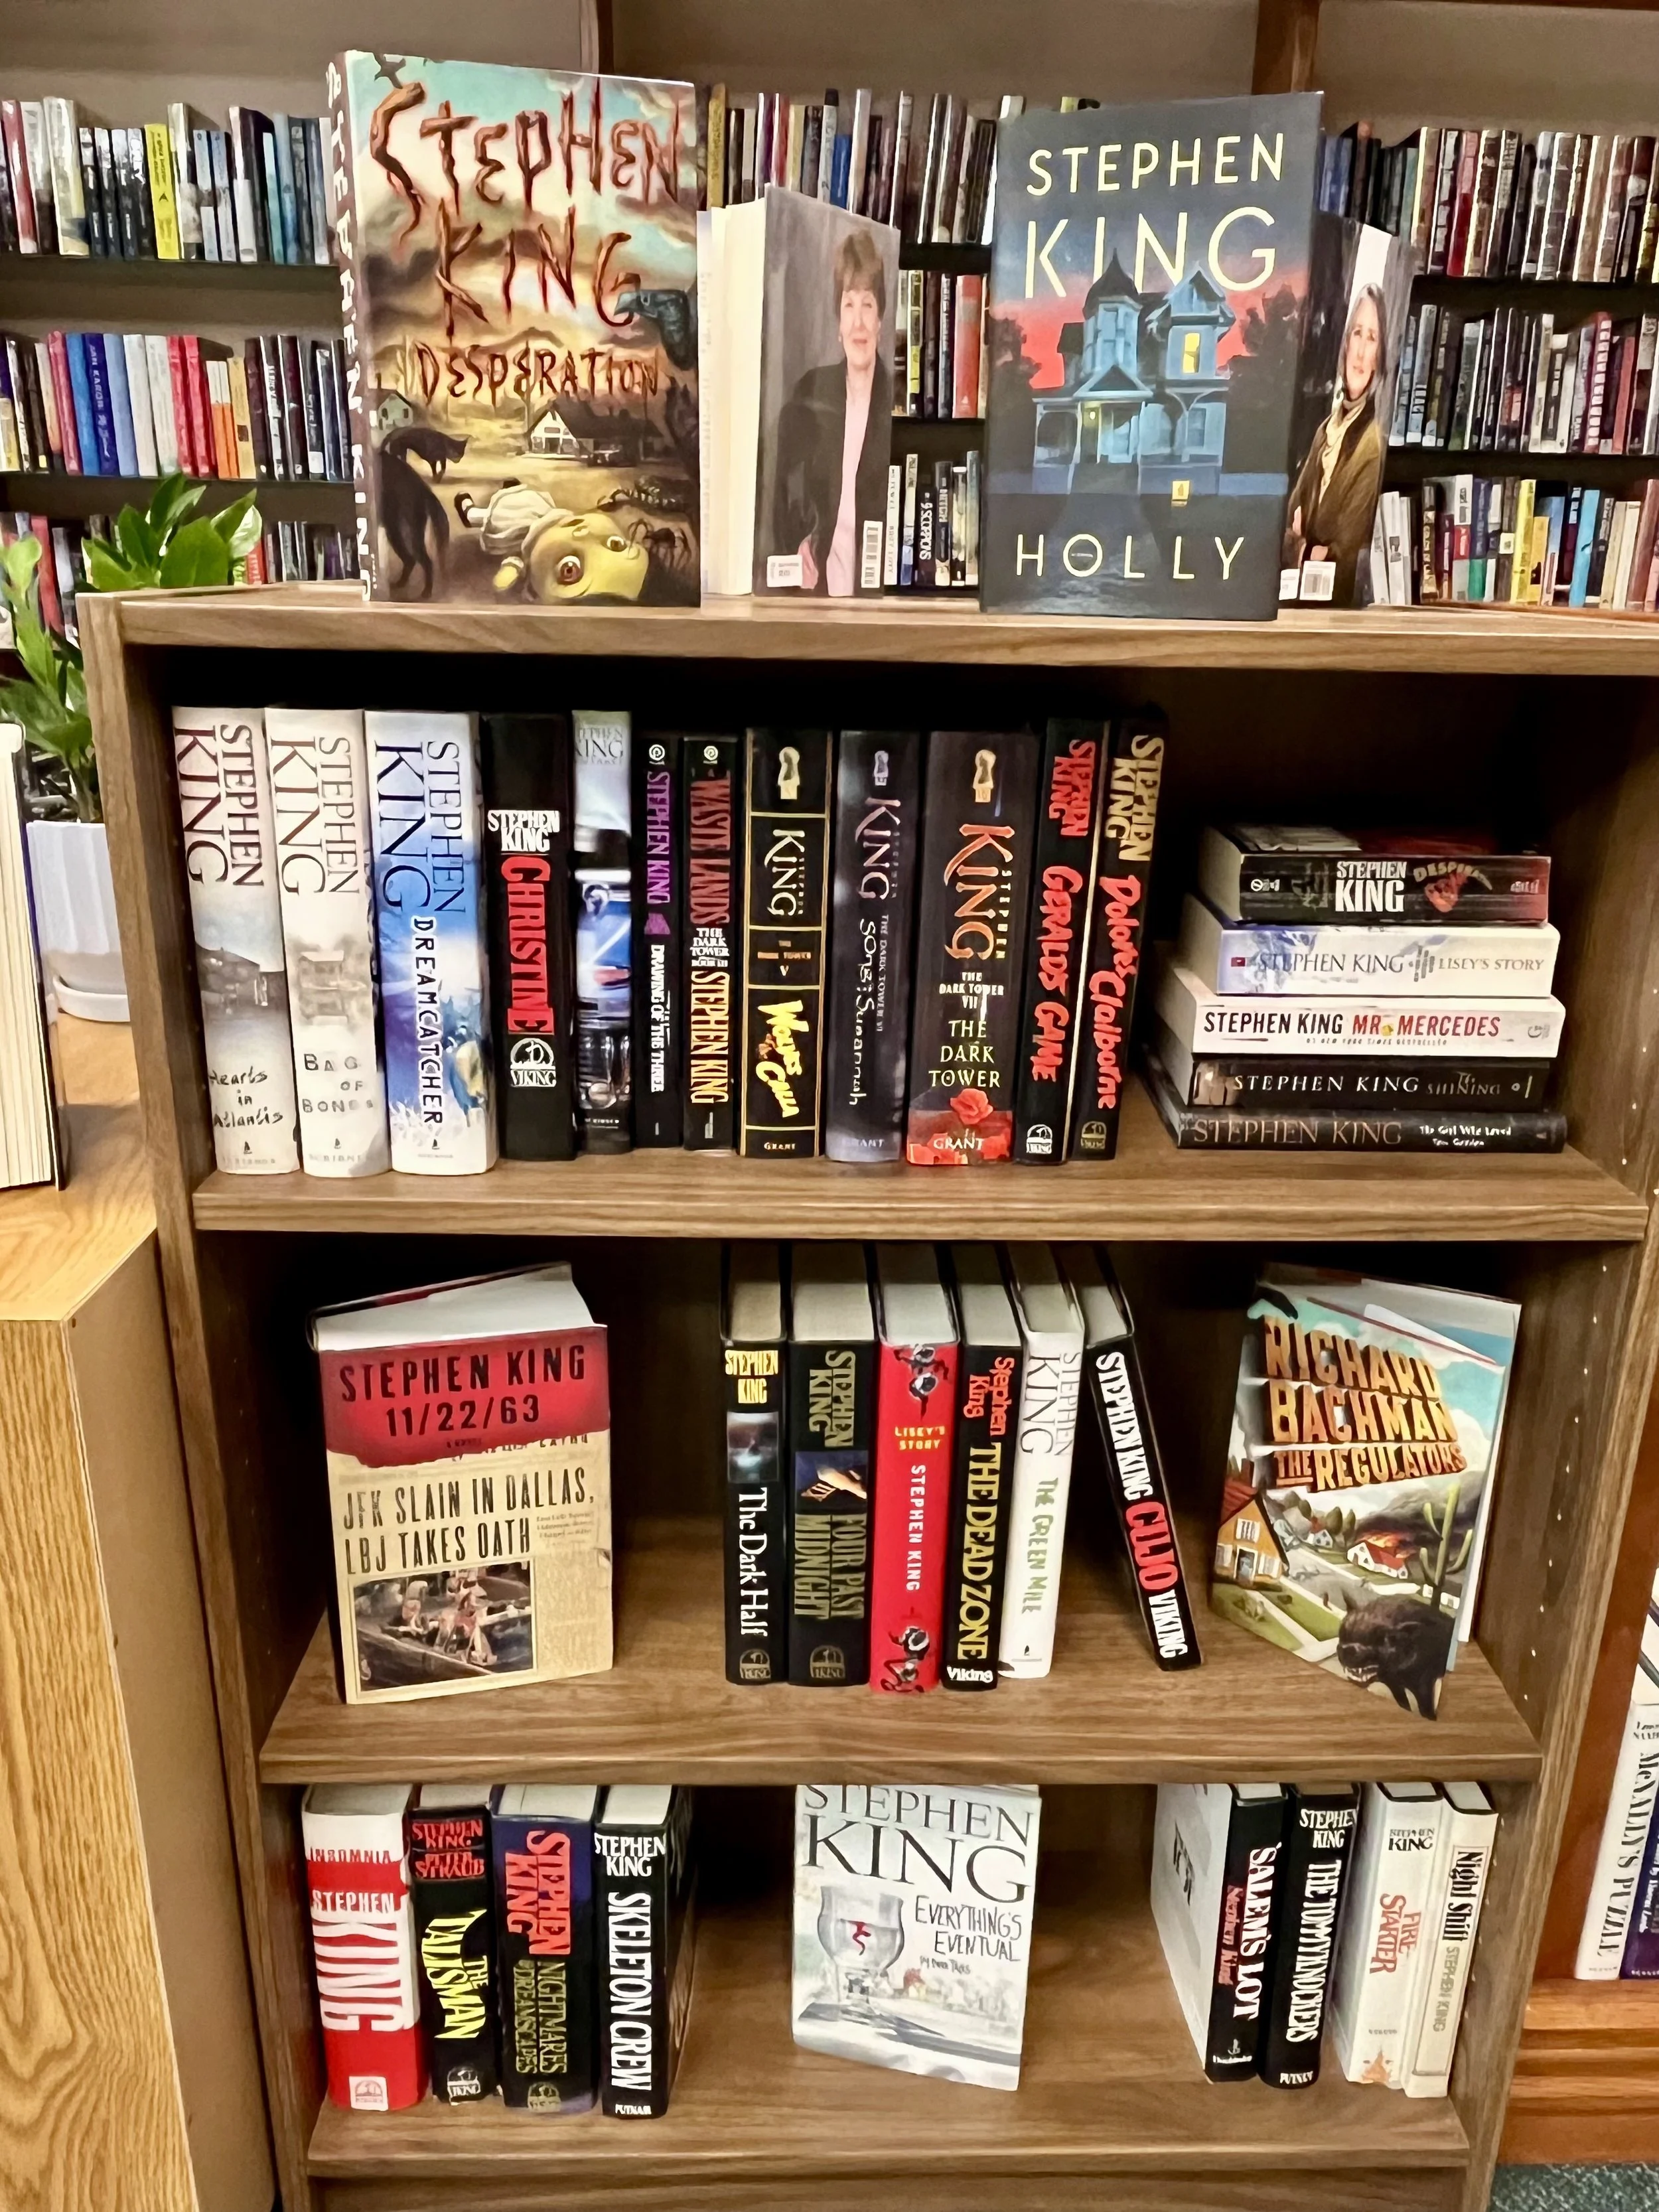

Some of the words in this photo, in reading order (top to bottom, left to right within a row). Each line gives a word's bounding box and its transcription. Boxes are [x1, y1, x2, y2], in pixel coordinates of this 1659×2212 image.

[370, 78, 680, 251] STEPHEN
[1027, 133, 1284, 196] STEPHEN
[435, 199, 641, 344] KING
[1024, 206, 1277, 299] KING
[411, 338, 661, 407] DESPERATION
[1015, 533, 1244, 581] HOLLY
[174, 725, 229, 884] KING
[220, 724, 264, 886] STEPHEN
[270, 735, 326, 896] KING
[319, 737, 360, 893] STEPHEN
[647, 771, 670, 855] STEPHEN
[1048, 756, 1072, 820] KING
[1060, 739, 1096, 836] STEPHEN
[1104, 757, 1138, 839] KING
[1118, 734, 1165, 861] STEPHEN
[374, 739, 431, 911] KING
[427, 741, 466, 913] STEPHEN
[488, 810, 560, 834] STEPHEN
[501, 827, 550, 853] KING
[855, 796, 901, 901] KING
[647, 860, 670, 904] KING
[690, 858, 731, 924] LANDS
[764, 829, 805, 916] KING
[943, 823, 1015, 960] KING
[1334, 879, 1406, 913] KING
[1335, 860, 1407, 879] STEPHEN
[501, 856, 555, 1035] CHRISTINE
[1259, 953, 1346, 973] STEPHEN
[1352, 953, 1406, 974] KING
[1494, 958, 1545, 972] STORY
[691, 970, 730, 1055] STEPHEN
[939, 984, 966, 995] DARK
[413, 918, 443, 1124] DREAMCATCHER
[948, 1020, 987, 1039] THE
[1030, 1001, 1070, 1083] GAME
[1204, 1011, 1291, 1035] STEPHEN
[1297, 1013, 1344, 1035] KING
[1397, 1015, 1502, 1037] MERCEDES
[304, 1053, 359, 1071] BAG
[510, 1069, 557, 1087] VIKING
[689, 1059, 729, 1104] KING
[928, 1069, 1001, 1088] TOWER
[940, 1045, 995, 1064] DARK
[1233, 1074, 1344, 1093] STEPHEN
[1356, 1076, 1421, 1093] KING
[238, 1089, 253, 1106] in
[340, 1080, 364, 1091] OF
[933, 1137, 985, 1150] GRANT
[1194, 1118, 1319, 1144] STEPHEN
[1332, 1120, 1402, 1145] KING
[339, 1353, 490, 1402] STEPHEN
[506, 1345, 585, 1386] KING
[725, 1350, 778, 1376] STEPHEN
[1264, 1314, 1443, 1400] RICHARD
[386, 1394, 540, 1437] 11/22/63
[738, 1378, 767, 1404] KING
[808, 1368, 833, 1432] KING
[825, 1350, 856, 1447] STEPHEN
[963, 1374, 991, 1418] King
[989, 1356, 1015, 1437] Stephen
[1020, 1353, 1064, 1455] KING
[1053, 1352, 1082, 1457] STEPHEN
[1096, 1351, 1144, 1450] STEPHEN
[1268, 1379, 1459, 1443] BACHMAN
[966, 1441, 1002, 1502] THE
[1116, 1445, 1153, 1501] KING
[1274, 1450, 1313, 1480] THE
[1313, 1441, 1469, 1492] REGULATORS
[343, 1490, 383, 1530] JFK
[394, 1480, 461, 1524] SLAIN
[472, 1477, 494, 1514] IN
[506, 1466, 595, 1511] DALLAS,
[738, 1487, 768, 1530] The
[907, 1464, 926, 1544] STEPHEN
[344, 1534, 387, 1576] LBJ
[398, 1525, 465, 1570] TAKES
[477, 1517, 530, 1559] OATH
[739, 1533, 768, 1585] Dark
[794, 1512, 831, 1620] MIDNIGHT
[905, 1550, 922, 1592] KING
[962, 1503, 998, 1582] DEAD
[1027, 1514, 1054, 1570] GREEN
[1125, 1501, 1179, 1590] CUJO
[740, 1588, 769, 1637] Half
[957, 1583, 993, 1660] ZONE
[1148, 1589, 1189, 1659] VIKING
[946, 1664, 994, 1684] Viking
[594, 1832, 666, 1858] STEPHEN
[804, 1785, 1033, 1847] STEPHEN
[1312, 1829, 1346, 1849] KING
[1388, 1836, 1433, 1852] KING
[606, 1856, 652, 1877] KING
[801, 1812, 1032, 1903] KING
[1304, 1859, 1342, 1899] THE
[1449, 1850, 1484, 1898] Night
[505, 1852, 539, 1935] KING
[526, 1829, 571, 1955] STEPHEN
[915, 1894, 1023, 1941] EVERYTHING'S
[1441, 1902, 1475, 1942] Shift
[607, 1891, 653, 2017] SKELETON
[934, 1931, 1021, 1962] EVENTUAL
[1368, 1893, 1407, 1975] STARTER
[1398, 1910, 1422, 1958] FIRE
[421, 1909, 488, 2039] TALISMAN
[463, 1954, 489, 1990] THE
[1232, 1962, 1264, 2021] LOT
[1441, 1946, 1460, 1997] STEPHEN
[537, 1961, 567, 2073] NIGHTMARES
[1433, 1996, 1450, 2033] KING
[610, 2020, 653, 2091] CREW
